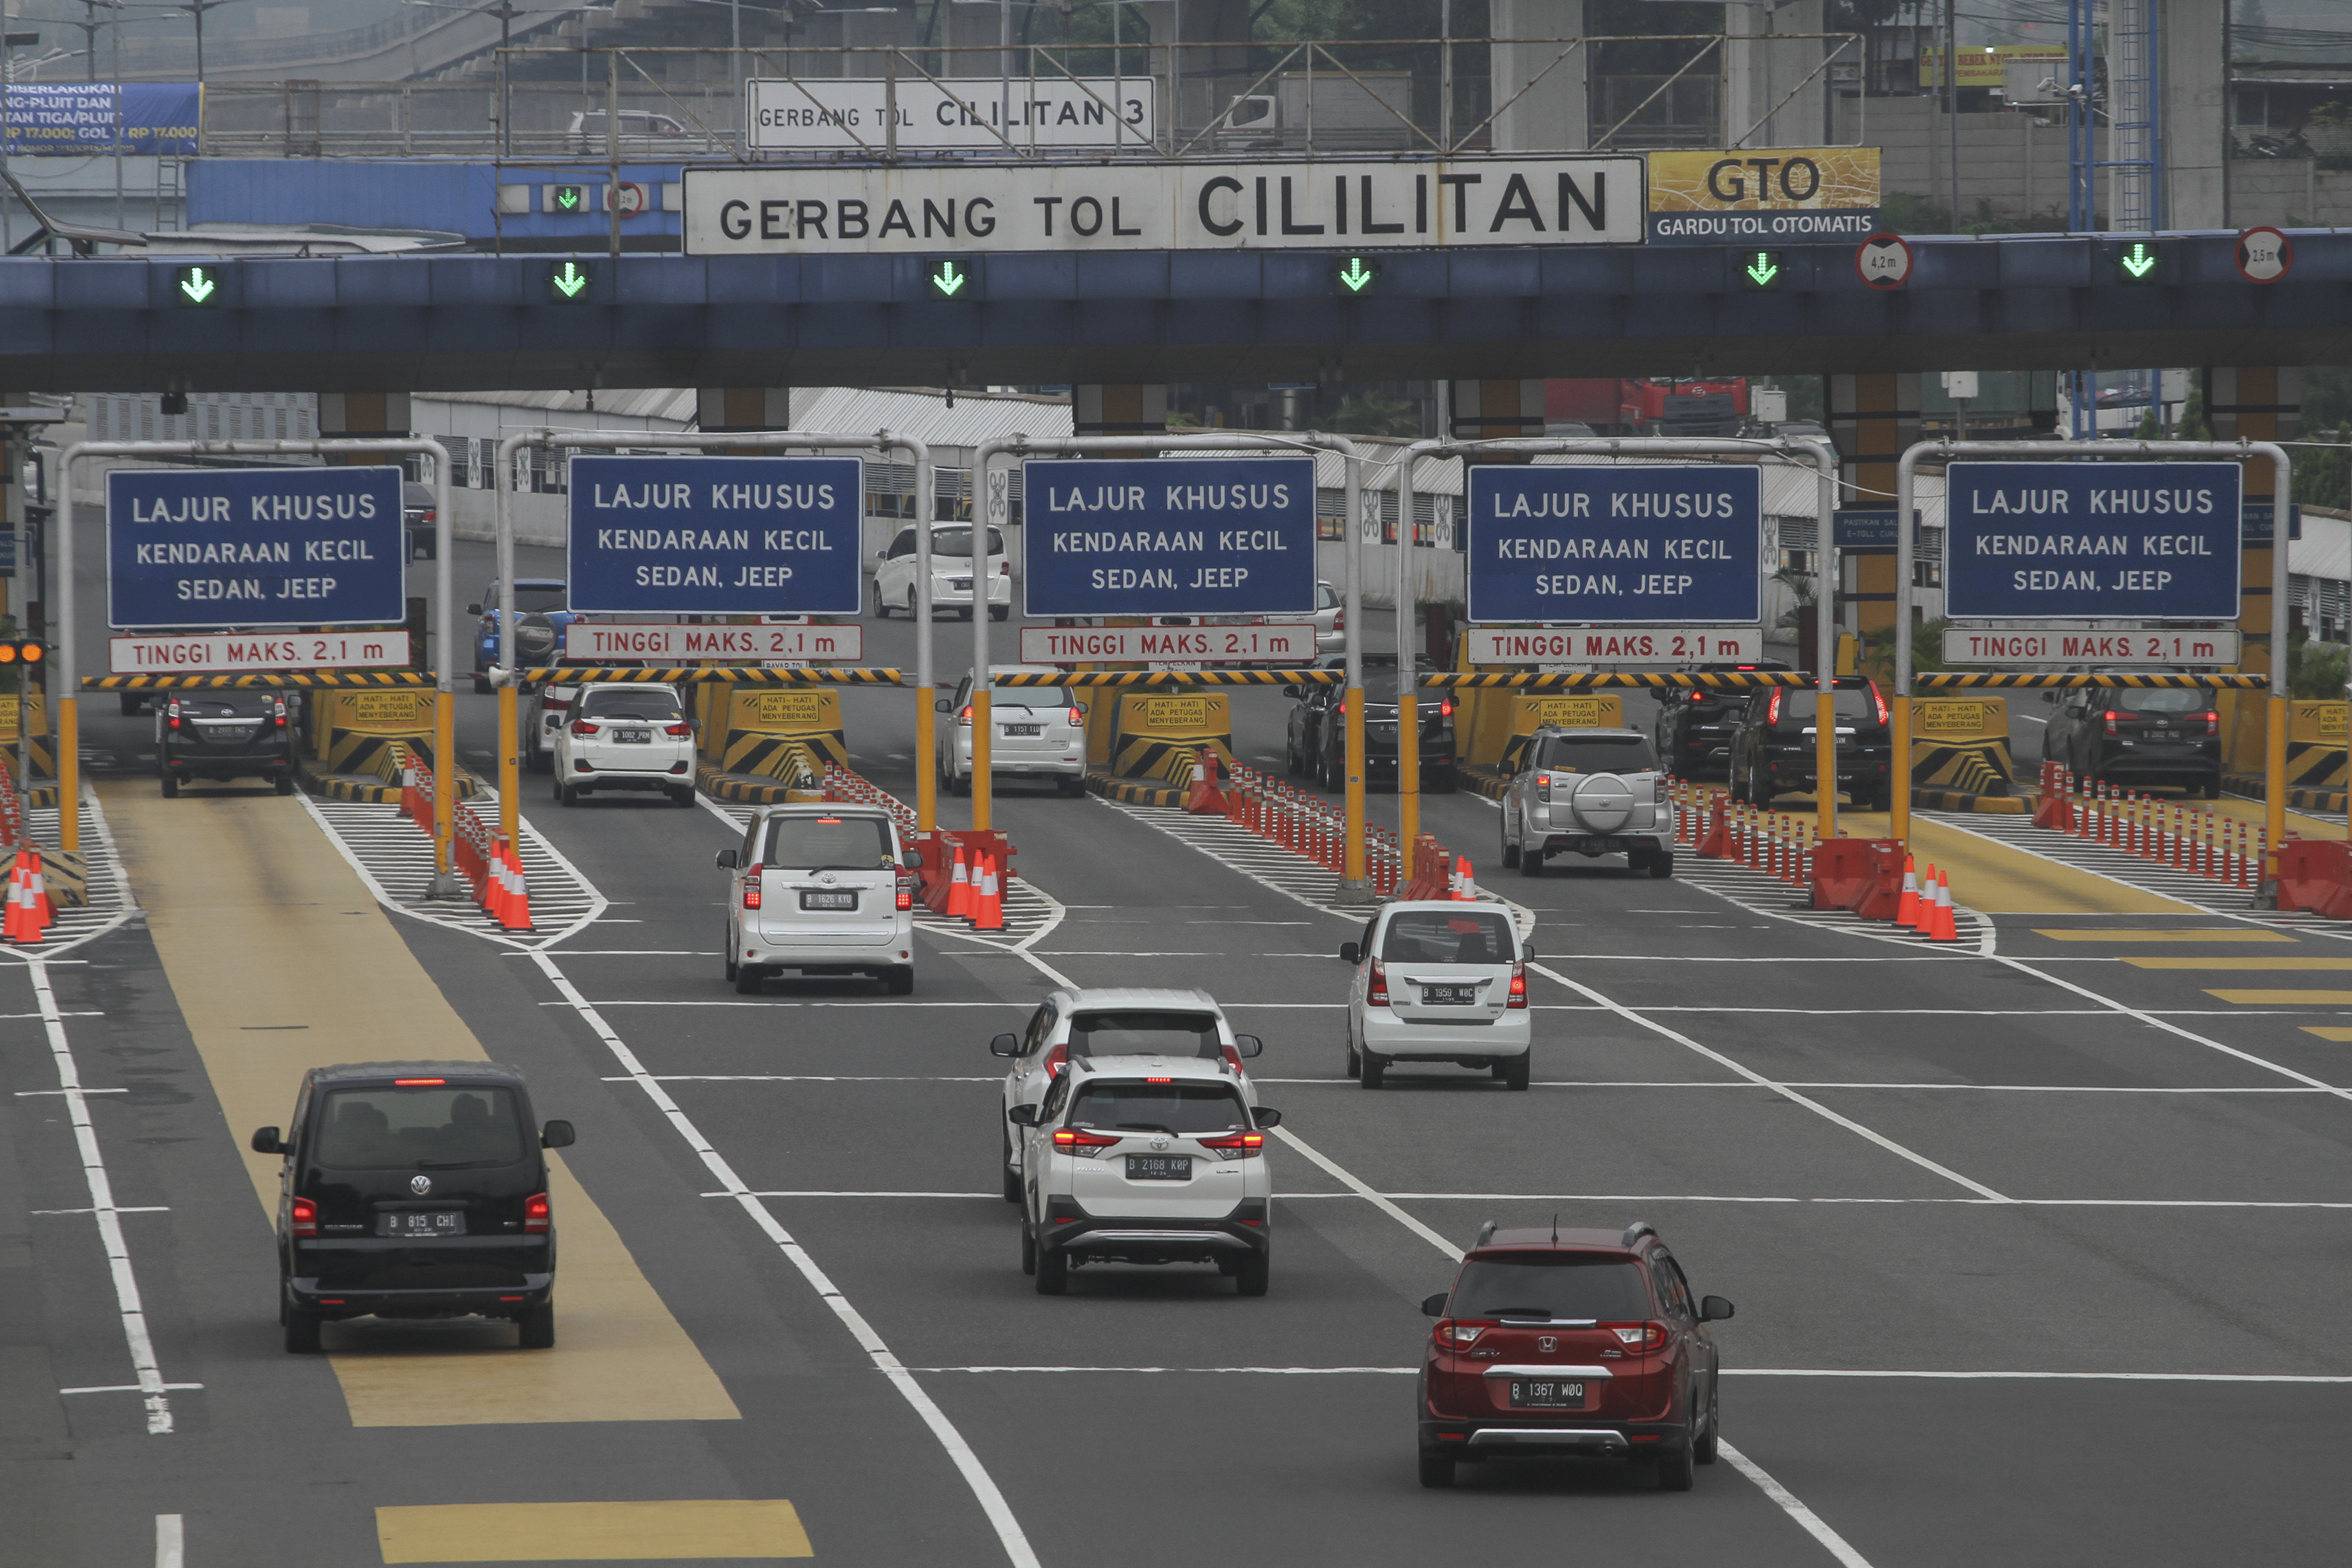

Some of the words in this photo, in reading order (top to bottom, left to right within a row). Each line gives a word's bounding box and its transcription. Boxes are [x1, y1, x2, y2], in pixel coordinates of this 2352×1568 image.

[76, 97, 111, 109] DAN
[759, 108, 859, 126] GERBANG
[1124, 99, 1144, 124] 3
[78, 127, 111, 139] GOL
[129, 128, 149, 139] RP
[1708, 158, 1819, 202] GTO
[721, 198, 995, 240] GERBANG
[1034, 196, 1141, 236] TOL
[1198, 171, 1606, 236] CILILITAN
[1657, 218, 1726, 236] GARDU
[1733, 218, 1768, 235] TOL
[1772, 215, 1872, 233] OTOMATIS
[595, 483, 691, 509] LAJUR
[712, 484, 834, 510] KHUSUS
[1050, 486, 1145, 511] LAJUR
[1167, 484, 1289, 510] KHUSUS
[1495, 493, 1590, 517] LAJUR
[1612, 493, 1733, 518] KHUSUS
[1973, 489, 2069, 514] LAJUR
[2090, 489, 2213, 514] KHUSUS
[133, 497, 230, 523] LAJUR
[252, 493, 375, 521] KHUSUS
[599, 529, 748, 550] KENDARAAN
[764, 530, 833, 550] KECIL
[1054, 531, 1203, 552] KENDARAAN
[1220, 530, 1287, 550] KECIL
[1499, 539, 1648, 559] KENDARAAN
[1665, 539, 1732, 559] KECIL
[1976, 535, 2127, 555] KENDARAAN
[2143, 535, 2211, 556] KECIL
[137, 542, 289, 564] KENDARAAN
[305, 540, 373, 561] KECIL
[733, 566, 793, 587] JEEP
[1190, 567, 1248, 588] JEEP
[1633, 574, 1692, 594] JEEP
[2112, 570, 2171, 590] JEEP
[276, 577, 336, 599] JEEP
[133, 644, 210, 664] TINGGI
[228, 641, 300, 662] MAKS.
[313, 640, 346, 661] 2,1
[363, 644, 383, 659] m
[592, 632, 669, 652] TINGGI
[686, 632, 758, 652] MAKS.
[770, 633, 803, 653] 2,1
[815, 637, 834, 652] m
[1047, 635, 1124, 655] TINGGI
[1141, 634, 1213, 654] MAKS.
[1225, 633, 1257, 654] 2,1
[1269, 637, 1289, 652] m
[1492, 636, 1571, 656] TINGGI
[1586, 636, 1659, 656] MAKS.
[1671, 636, 1705, 660] 2,1
[1718, 640, 1739, 656] m
[1969, 637, 2046, 657] TINGGI
[2063, 637, 2133, 657] MAKS.
[2147, 637, 2180, 660] 2,1
[2193, 642, 2214, 657] m
[807, 894, 812, 903] B
[818, 894, 835, 903] 1626
[838, 894, 851, 903] KYU
[1424, 988, 1429, 997] B
[1435, 988, 1452, 997] 1959
[1129, 1161, 1135, 1170] B
[1142, 1160, 1165, 1170] 2168
[390, 1216, 396, 1228] B
[408, 1215, 427, 1227] 815
[436, 1214, 455, 1227] CHI
[1512, 1383, 1519, 1396] B
[1529, 1383, 1554, 1396] 1367
